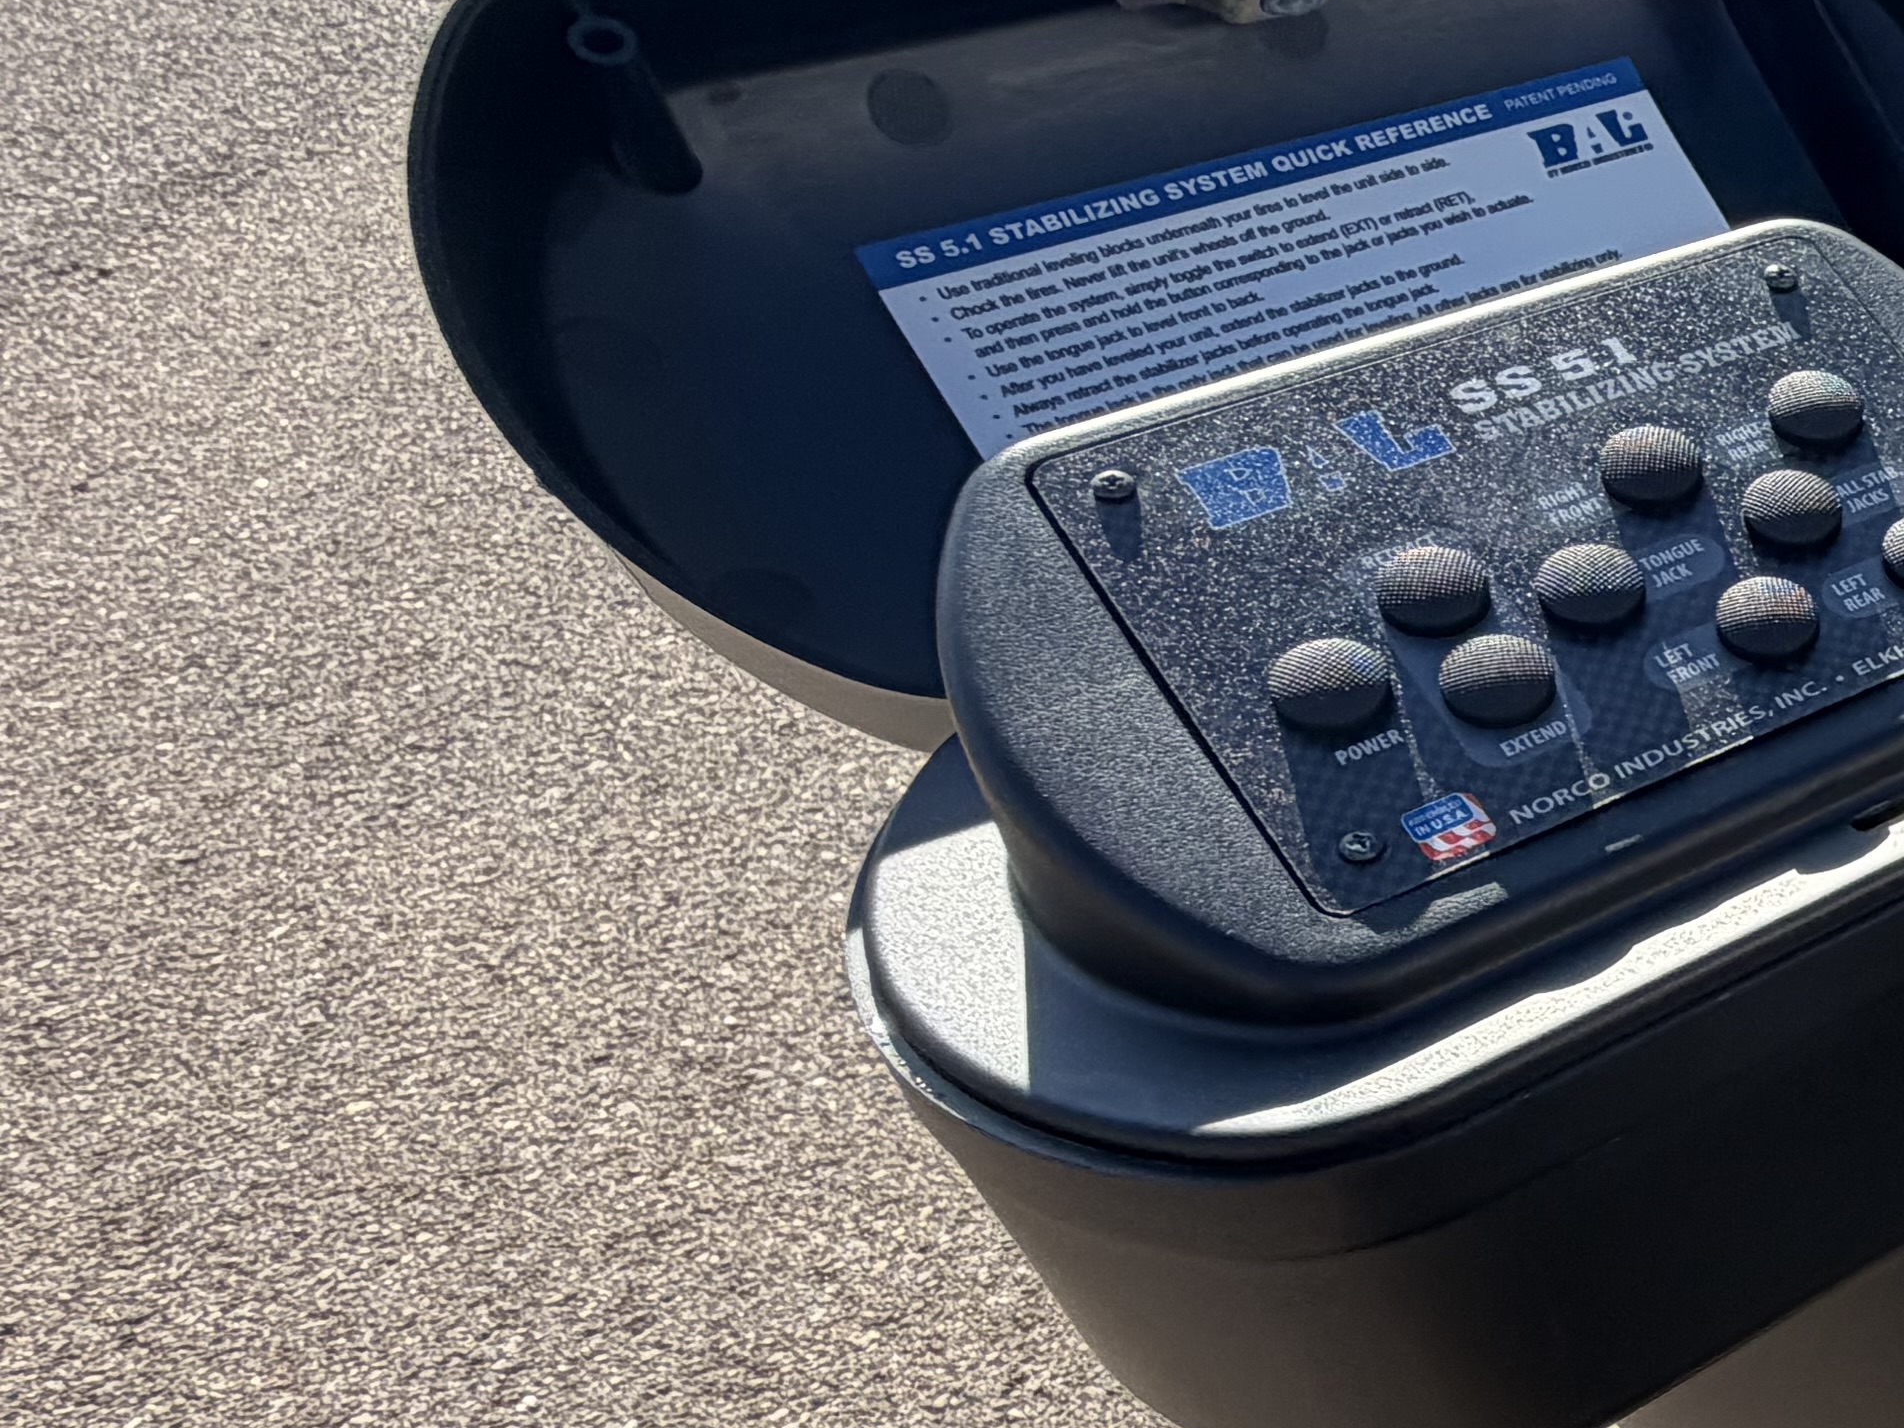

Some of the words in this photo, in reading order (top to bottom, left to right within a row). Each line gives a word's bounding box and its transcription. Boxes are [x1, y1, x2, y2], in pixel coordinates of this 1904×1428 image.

[895, 245, 935, 268] SS
[939, 233, 982, 256] 5.1
[988, 188, 1160, 244] STABILIZING
[1163, 161, 1268, 199] SYSTEM
[1271, 139, 1353, 171] QUICK
[1354, 103, 1492, 150] REFERENCE
[1503, 88, 1554, 110] PATENT
[1555, 72, 1616, 96] PENDING
[936, 284, 970, 299] Use
[970, 262, 1042, 291] traditional
[1041, 250, 1100, 272] leveling
[1097, 238, 1145, 257] blocks
[1145, 216, 1222, 245] underneath
[1221, 209, 1251, 227] your
[1252, 201, 1283, 215] tires
[1282, 197, 1299, 208] to
[1297, 186, 1330, 204] level
[1329, 183, 1352, 195] the
[1353, 174, 1378, 189] unit
[1378, 168, 1405, 183] side
[1404, 165, 1419, 175] to
[949, 298, 1000, 320] Chock
[998, 293, 1025, 307] the
[1062, 270, 1106, 290] Never
[1106, 263, 1128, 278] lift
[1126, 259, 1151, 272] the
[1189, 235, 1238, 255] wheels
[1238, 227, 1256, 242] off
[1256, 224, 1280, 237] the
[1281, 209, 1331, 233] ground.
[960, 326, 983, 339] To
[984, 312, 1041, 334] operate
[1040, 305, 1066, 318] the
[1124, 276, 1168, 296] simply
[1168, 264, 1212, 283] toggle
[1211, 258, 1236, 271] the
[1237, 245, 1279, 265] switch
[1278, 242, 1294, 252] to
[1295, 227, 1339, 248] extend
[1339, 216, 1378, 238] (EXT)
[1378, 214, 1392, 225] or
[1393, 202, 1434, 221] retract
[974, 340, 1004, 358] and
[1003, 332, 1039, 349] then
[1039, 321, 1081, 342] press
[1082, 310, 1111, 327] and
[1109, 301, 1143, 320] hold
[1142, 297, 1167, 310] the
[1166, 284, 1212, 303] button
[1212, 258, 1306, 291] corresponding
[1303, 254, 1320, 264] to
[1319, 248, 1342, 260] the
[1342, 238, 1371, 257] jack
[1370, 235, 1384, 246] or
[1385, 226, 1419, 245] jacks
[1418, 219, 1443, 235] you
[1442, 210, 1472, 225] wish
[1471, 207, 1486, 217] to
[984, 362, 1018, 377] Use
[1018, 354, 1044, 368] the
[1044, 340, 1095, 361] tongue
[1094, 329, 1128, 348] jack
[1126, 326, 1143, 337] to
[1141, 313, 1178, 333] level
[1177, 305, 1212, 323] front
[1210, 302, 1227, 313] to
[1000, 379, 1034, 397] After
[1036, 371, 1065, 389] you
[1064, 361, 1103, 378] have
[1101, 342, 1154, 367] leveled
[1154, 335, 1186, 355] your
[1219, 310, 1265, 333] extend
[1264, 306, 1288, 320] the
[1288, 289, 1345, 313] stabilizer
[1345, 279, 1381, 299] jacks
[1379, 275, 1395, 285] to
[1394, 269, 1417, 281] the
[1012, 395, 1065, 417] Always
[1065, 378, 1113, 401] retract
[1112, 373, 1138, 387] the
[1138, 354, 1199, 380] stabilizer
[1199, 344, 1237, 364] jacks
[1235, 331, 1281, 350] before
[1281, 312, 1343, 337] operating
[1341, 306, 1364, 319] the
[1363, 292, 1409, 311] tongue
[1450, 365, 1542, 414] SS
[1474, 361, 1675, 441] STABILIZING
[1679, 321, 1801, 374] SYSTEM
[1728, 439, 1769, 462] REAR
[1537, 482, 1587, 510] RIGHT
[1835, 480, 1863, 497] ALL
[1846, 488, 1890, 514] JACKS
[1549, 496, 1605, 527] FRONT
[1638, 538, 1704, 571] TONGUE
[1652, 562, 1691, 589] JACK
[1832, 572, 1868, 597] LEFT
[1844, 586, 1886, 613] REAR
[1654, 642, 1694, 670] LEFT
[1667, 653, 1721, 684] FRONT
[1335, 729, 1404, 766] POWER
[1499, 720, 1568, 759] EXTEND
[1509, 772, 1611, 825] NORCO
[1614, 704, 1774, 779] INDUSTRIES,
[1775, 680, 1828, 710] INC.
